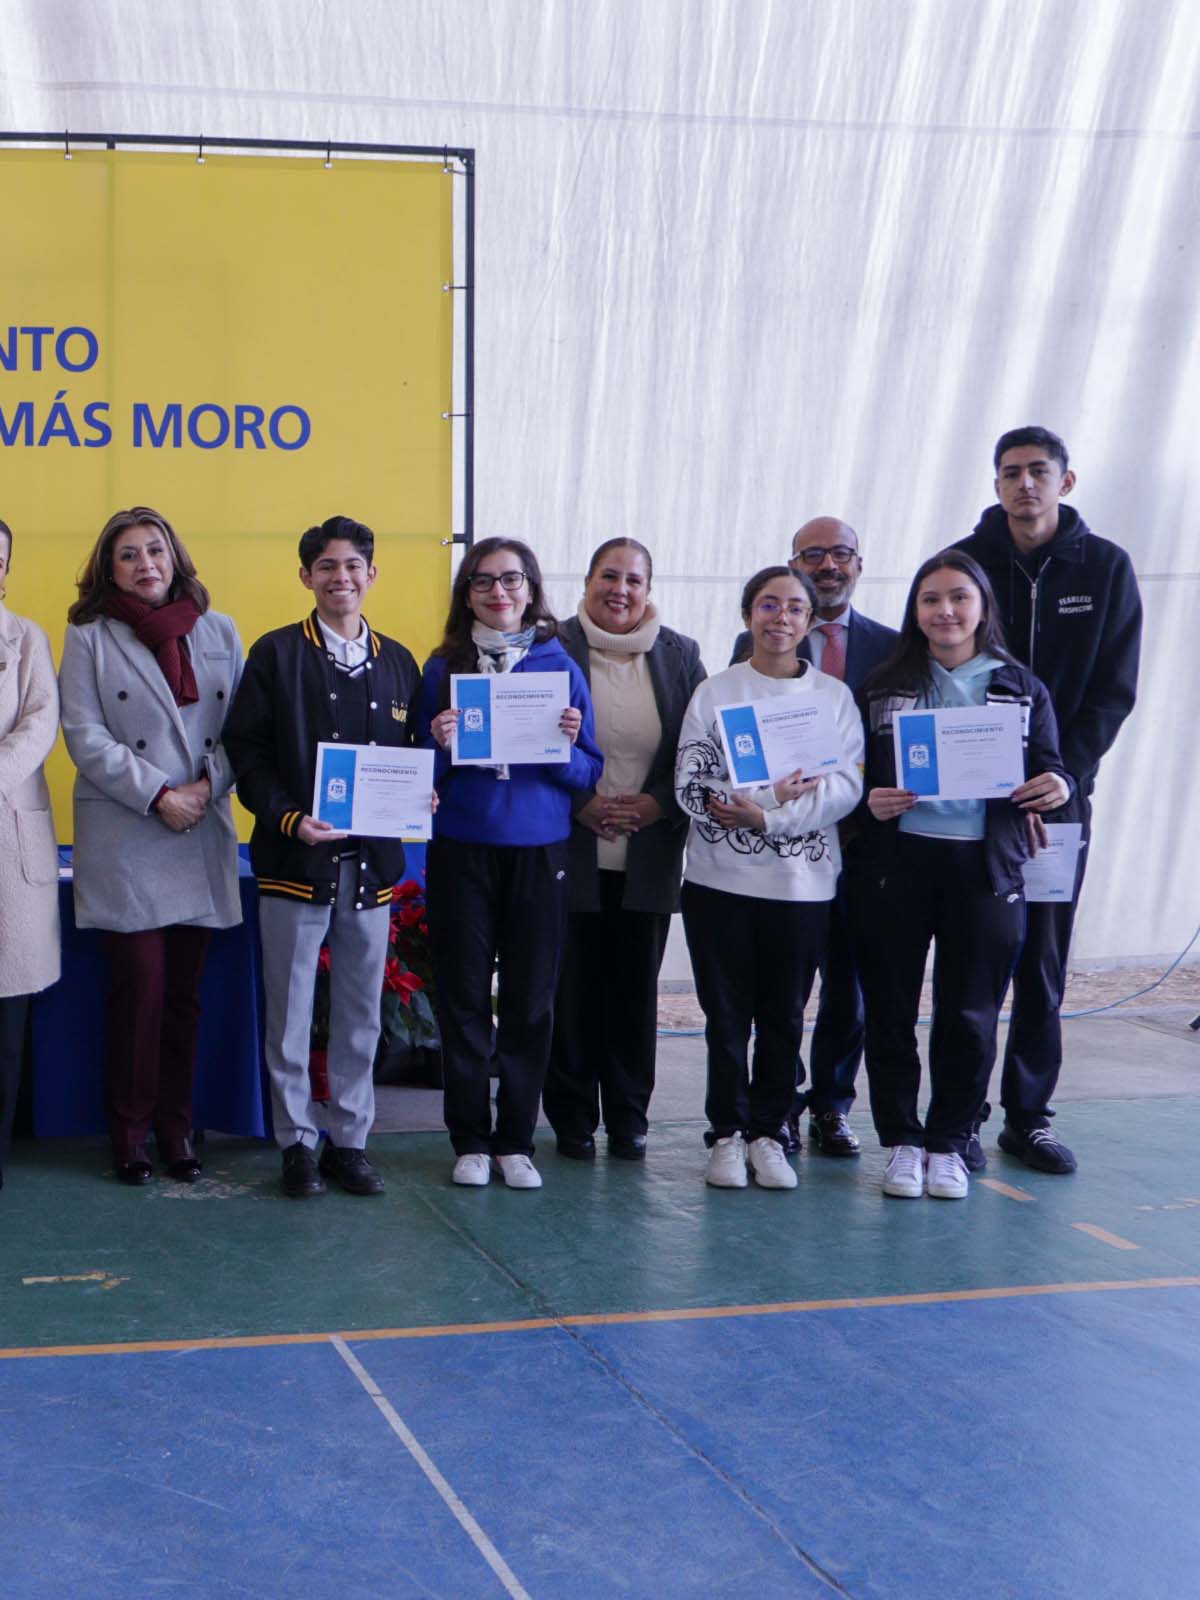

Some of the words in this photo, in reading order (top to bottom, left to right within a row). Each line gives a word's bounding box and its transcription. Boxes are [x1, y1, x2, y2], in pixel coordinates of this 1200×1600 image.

[133, 403, 311, 450] MORO
[942, 726, 1004, 735] RECONOCIMIENTO
[360, 767, 418, 776] RECONOCIMIENTO
